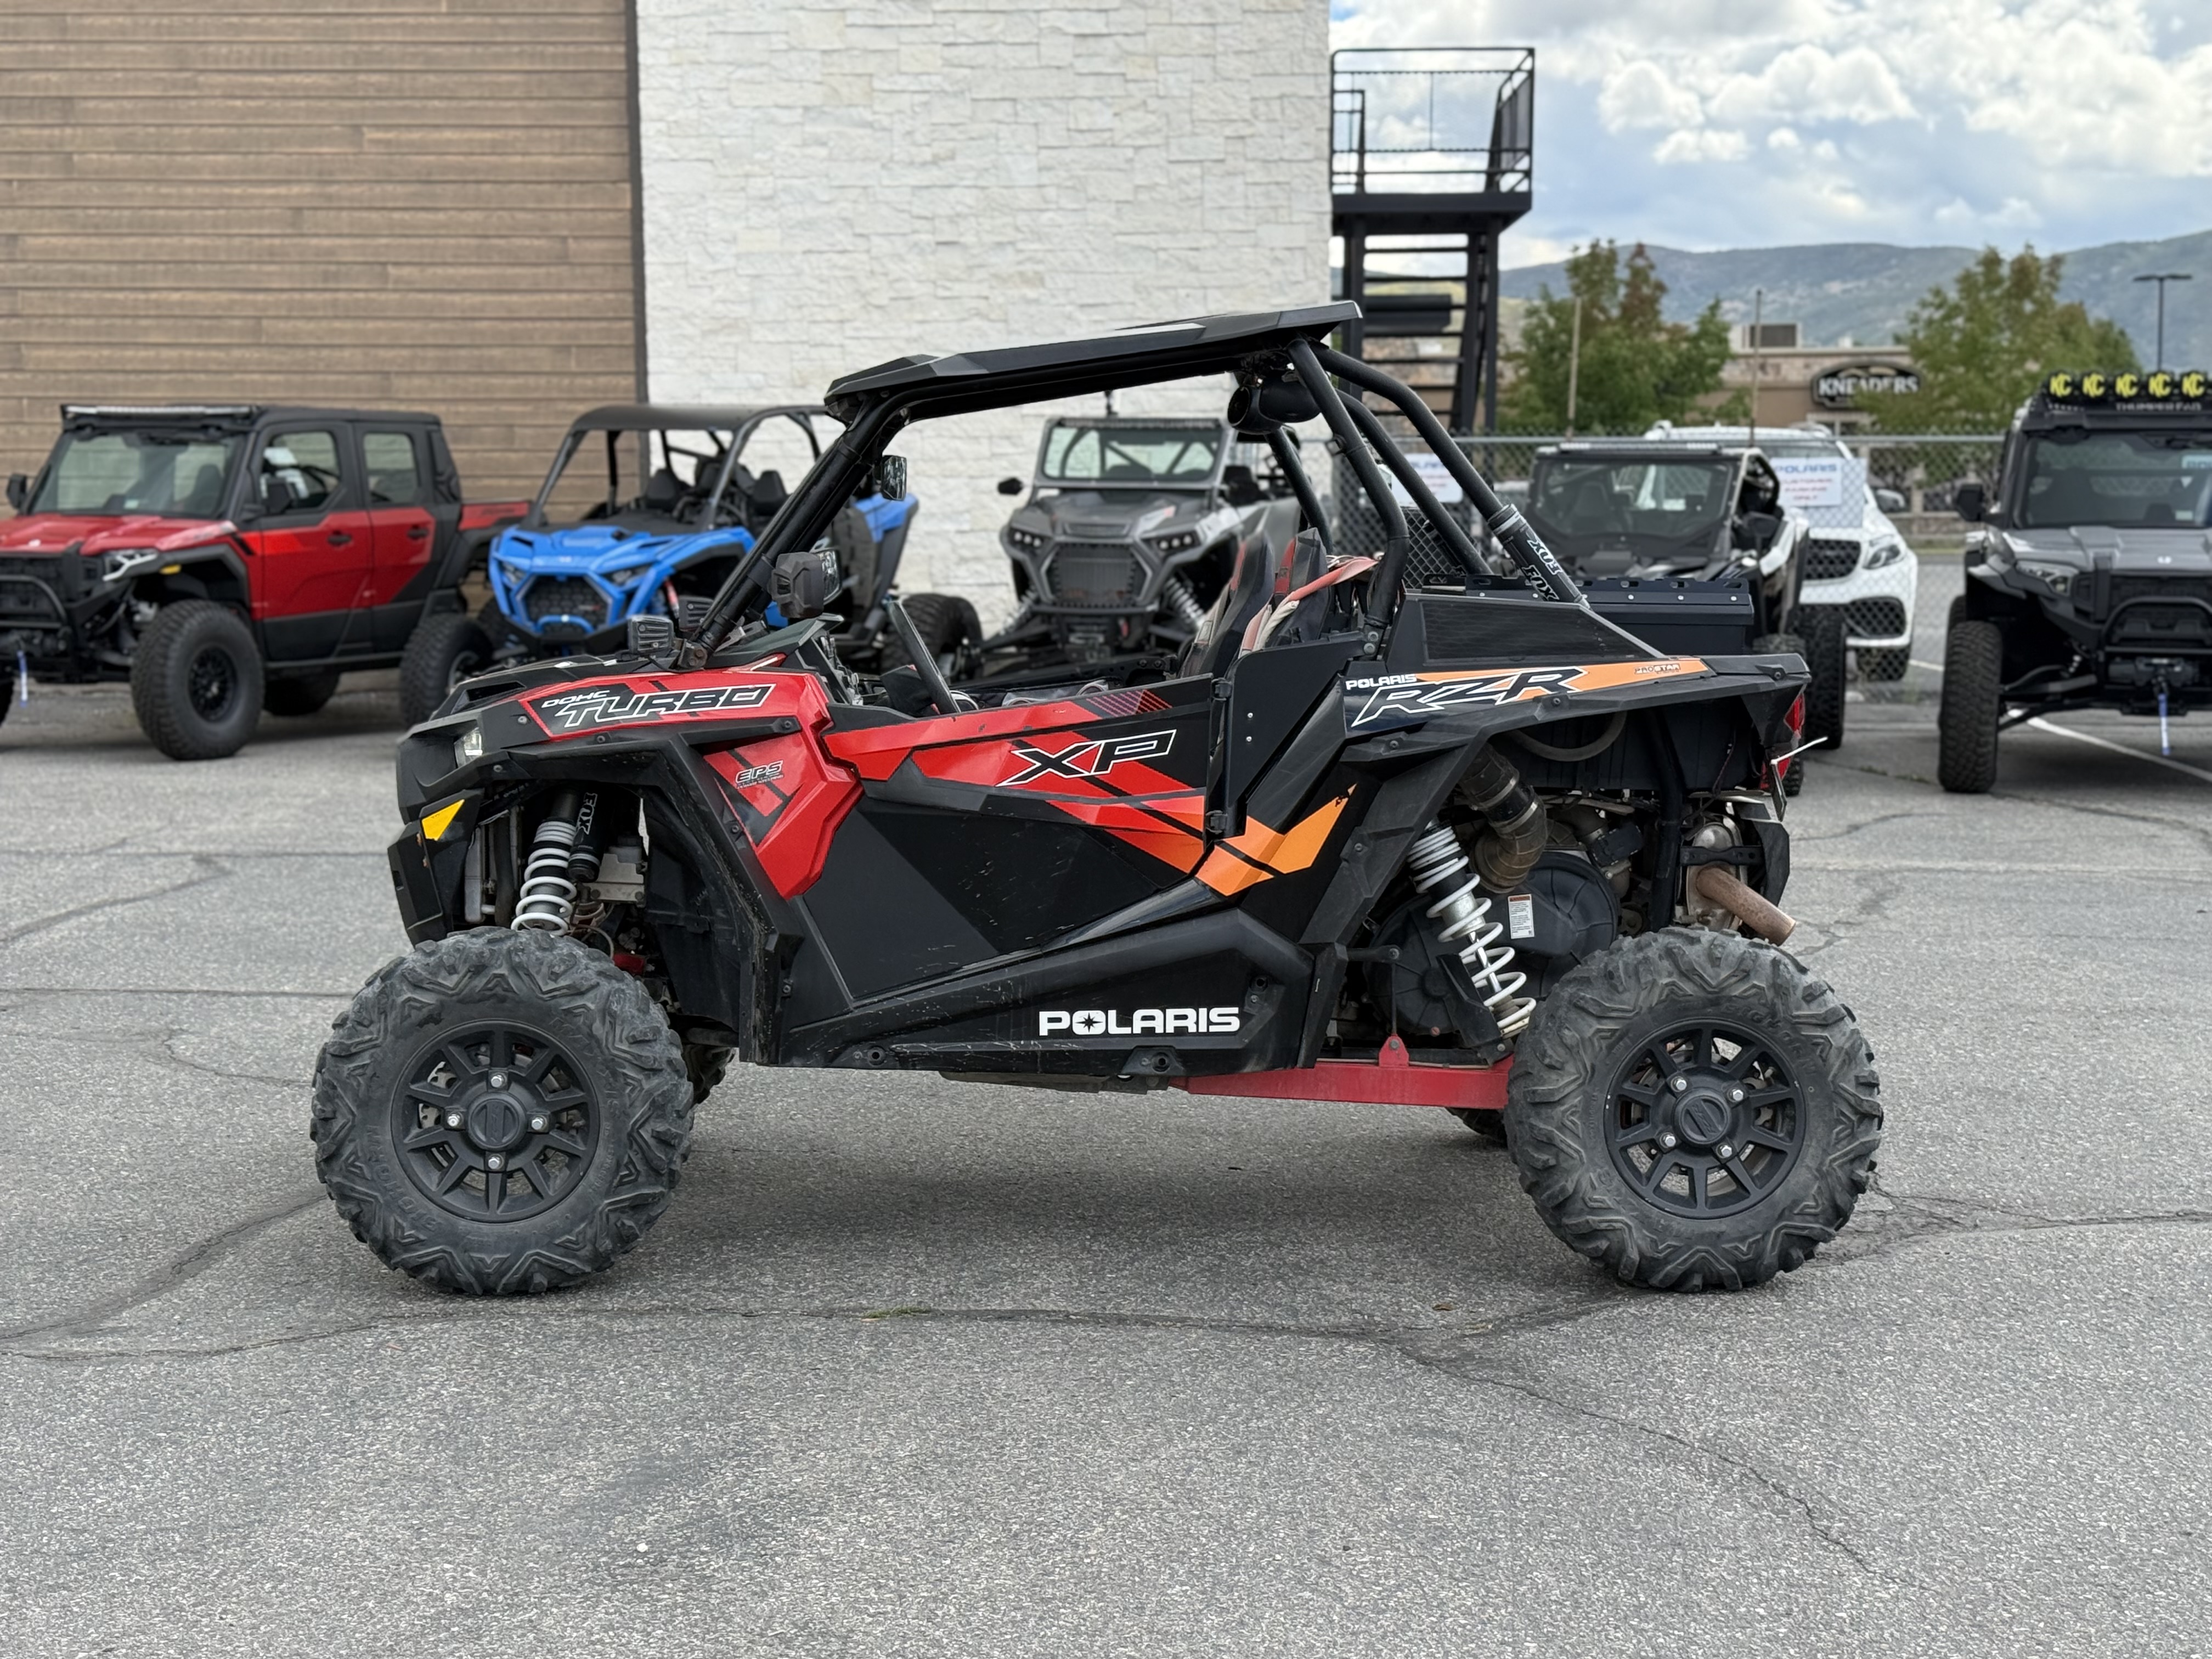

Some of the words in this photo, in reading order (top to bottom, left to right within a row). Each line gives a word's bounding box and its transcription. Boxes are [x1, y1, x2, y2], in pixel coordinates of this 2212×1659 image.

[2050, 373, 2072, 397] KC
[2083, 373, 2105, 397] KC
[2115, 373, 2138, 397] KC
[2148, 373, 2171, 397] KC
[2181, 373, 2205, 397] KC
[1527, 539, 1563, 575] FOX
[1521, 565, 1560, 601] FOX
[541, 690, 610, 708] DOHC
[1346, 674, 1417, 690] POLARIS
[1351, 666, 1589, 727] RZR
[555, 684, 776, 728] TURBO
[736, 760, 783, 783] EPS
[995, 729, 1176, 787] XP
[574, 792, 598, 836] FOX
[1039, 1007, 1240, 1036] POLARIS
